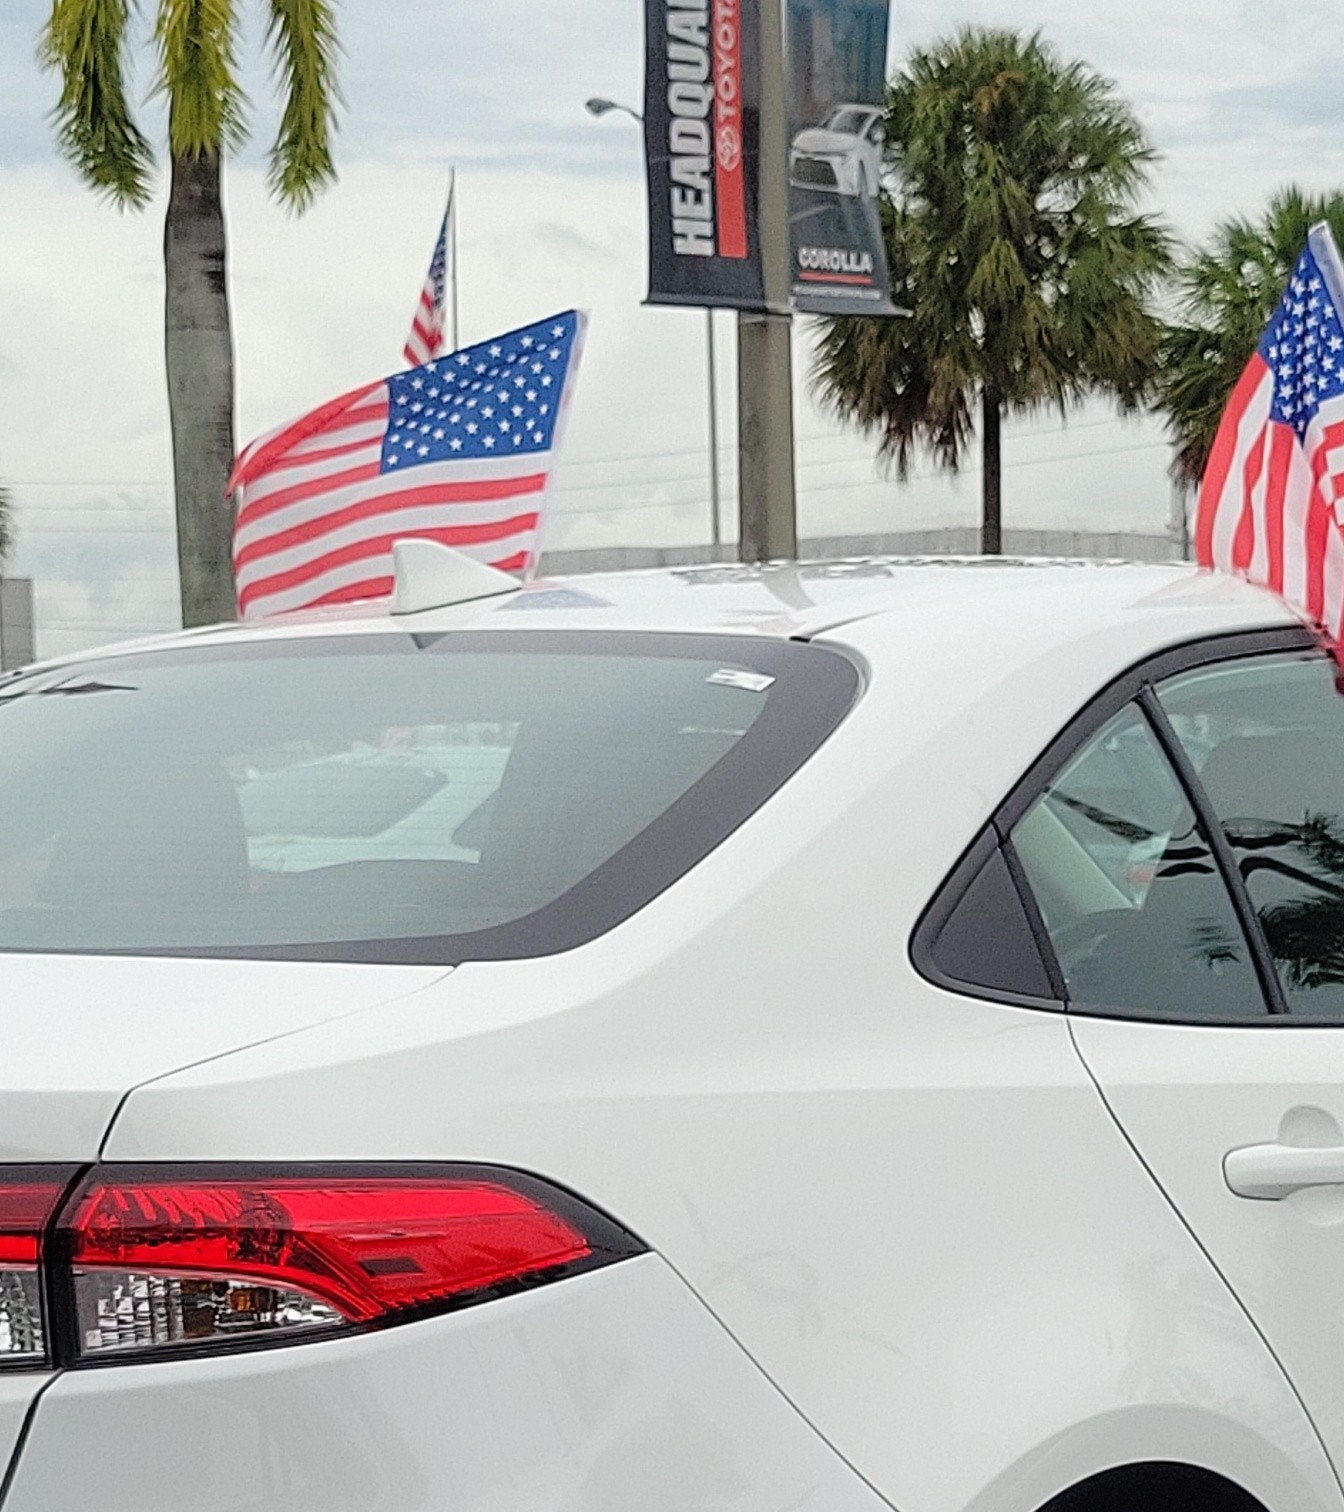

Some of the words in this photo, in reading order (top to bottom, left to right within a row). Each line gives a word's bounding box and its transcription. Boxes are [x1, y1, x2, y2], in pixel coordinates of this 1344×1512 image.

[716, 0, 739, 123] TOYOT
[666, 0, 716, 257] HEADQUA
[798, 247, 873, 274] COROLLA
